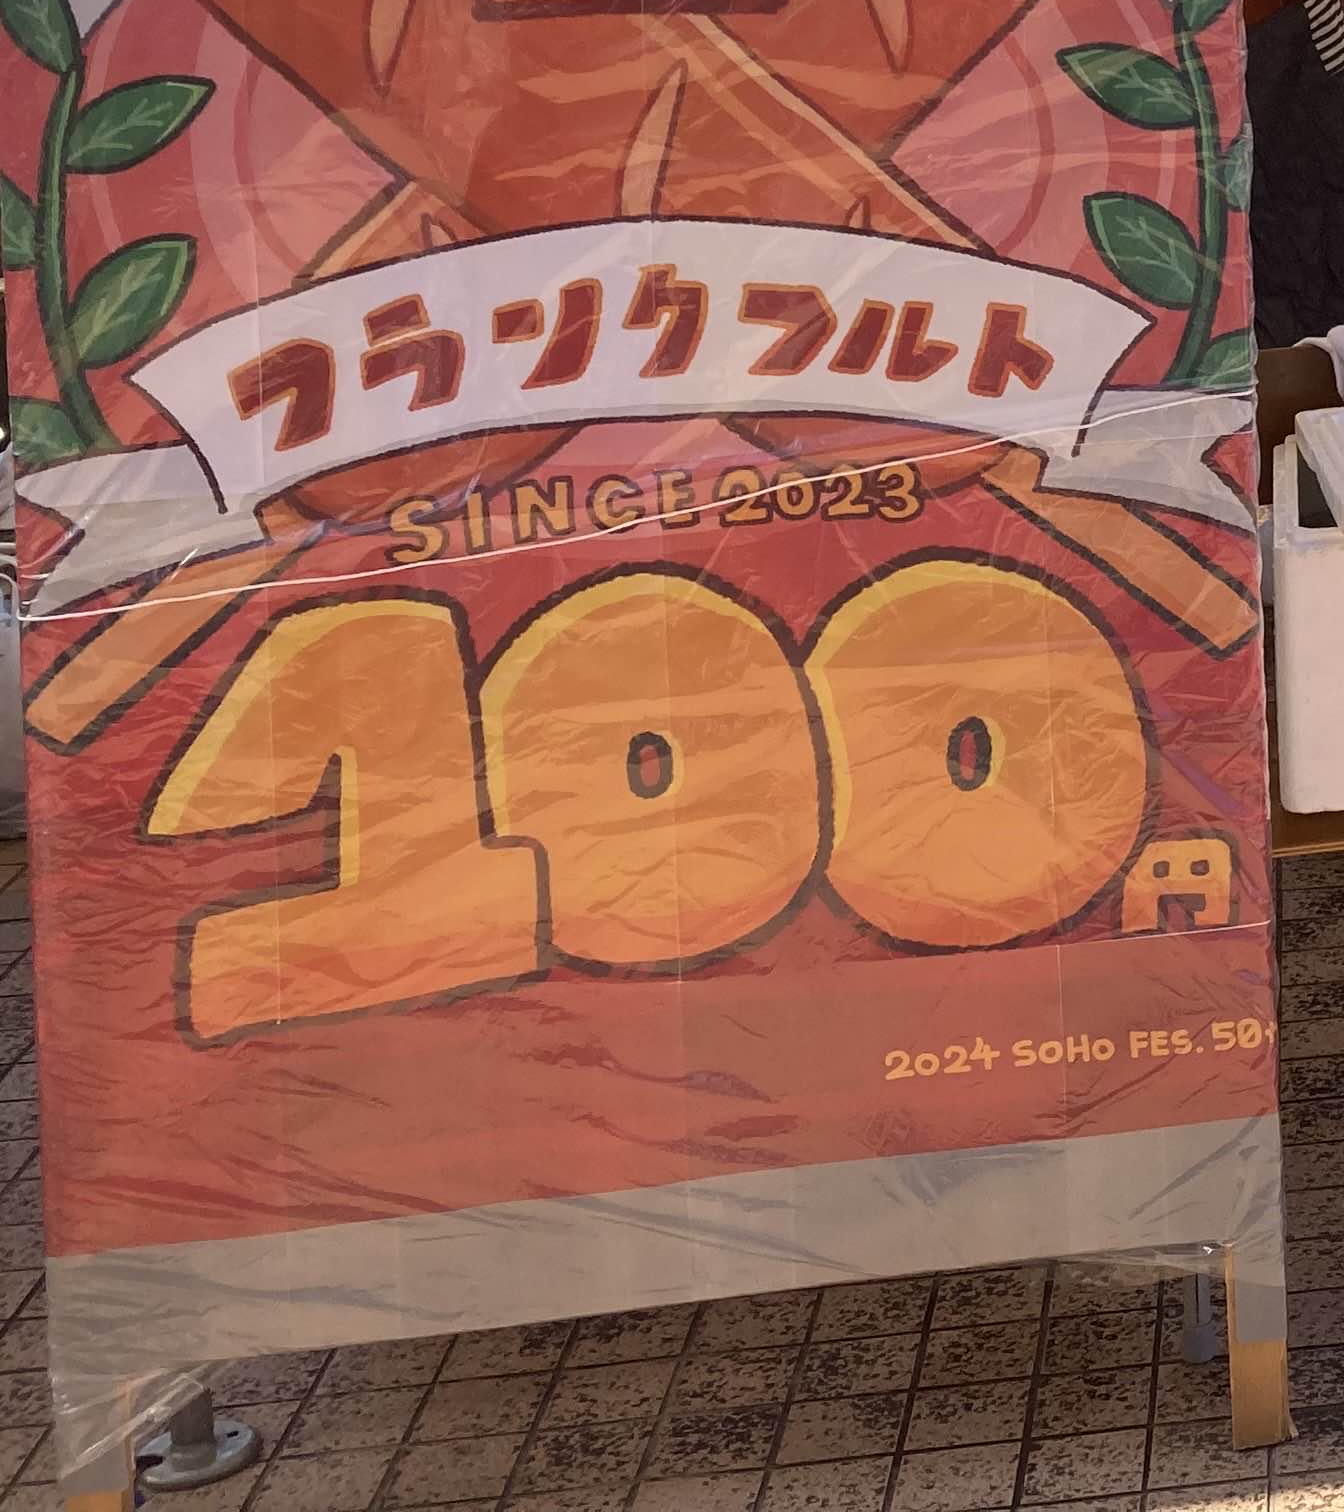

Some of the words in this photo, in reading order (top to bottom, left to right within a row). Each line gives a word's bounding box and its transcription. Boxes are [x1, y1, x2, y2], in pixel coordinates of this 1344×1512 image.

[228, 263, 1057, 452] フランクフルト
[389, 470, 695, 565] SINCE
[723, 461, 924, 527] 2023
[139, 559, 1240, 1046] 100円
[884, 1037, 1000, 1081] 2024
